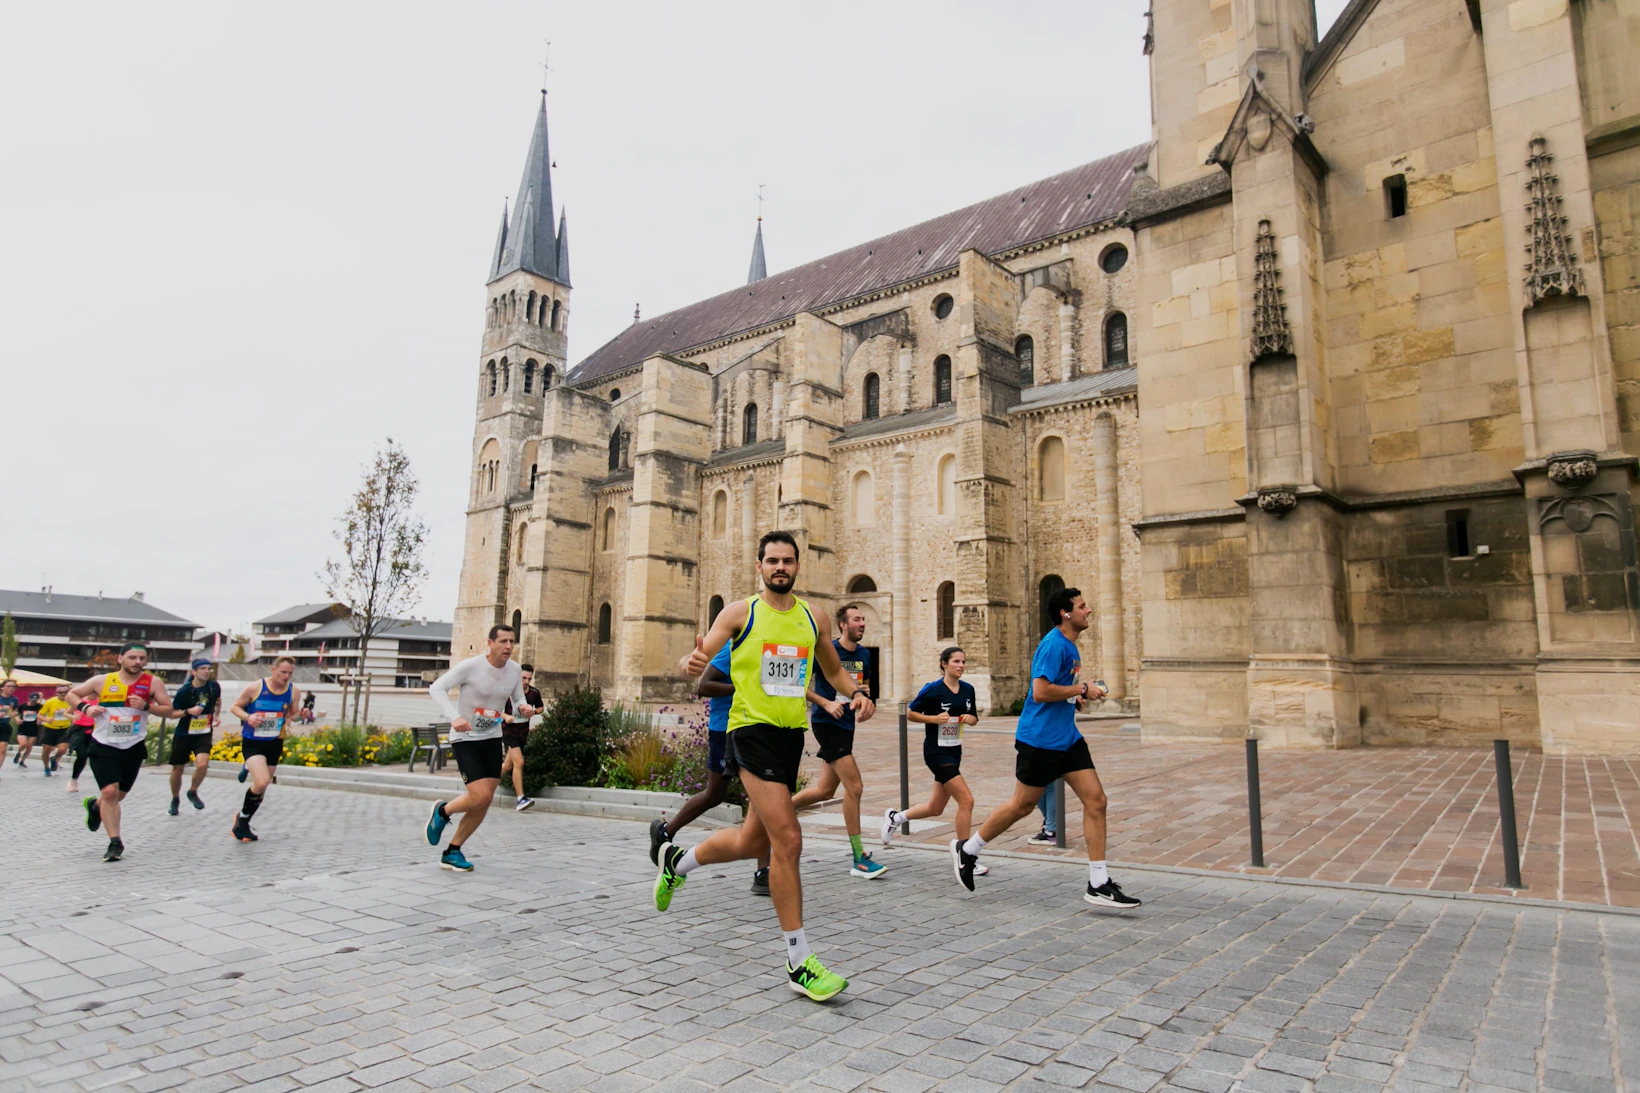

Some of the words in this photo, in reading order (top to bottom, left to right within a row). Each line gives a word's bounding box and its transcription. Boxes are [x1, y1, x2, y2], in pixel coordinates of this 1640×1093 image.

[768, 661, 795, 678] 3131
[112, 724, 131, 734] 3083
[942, 726, 958, 736] 2620
